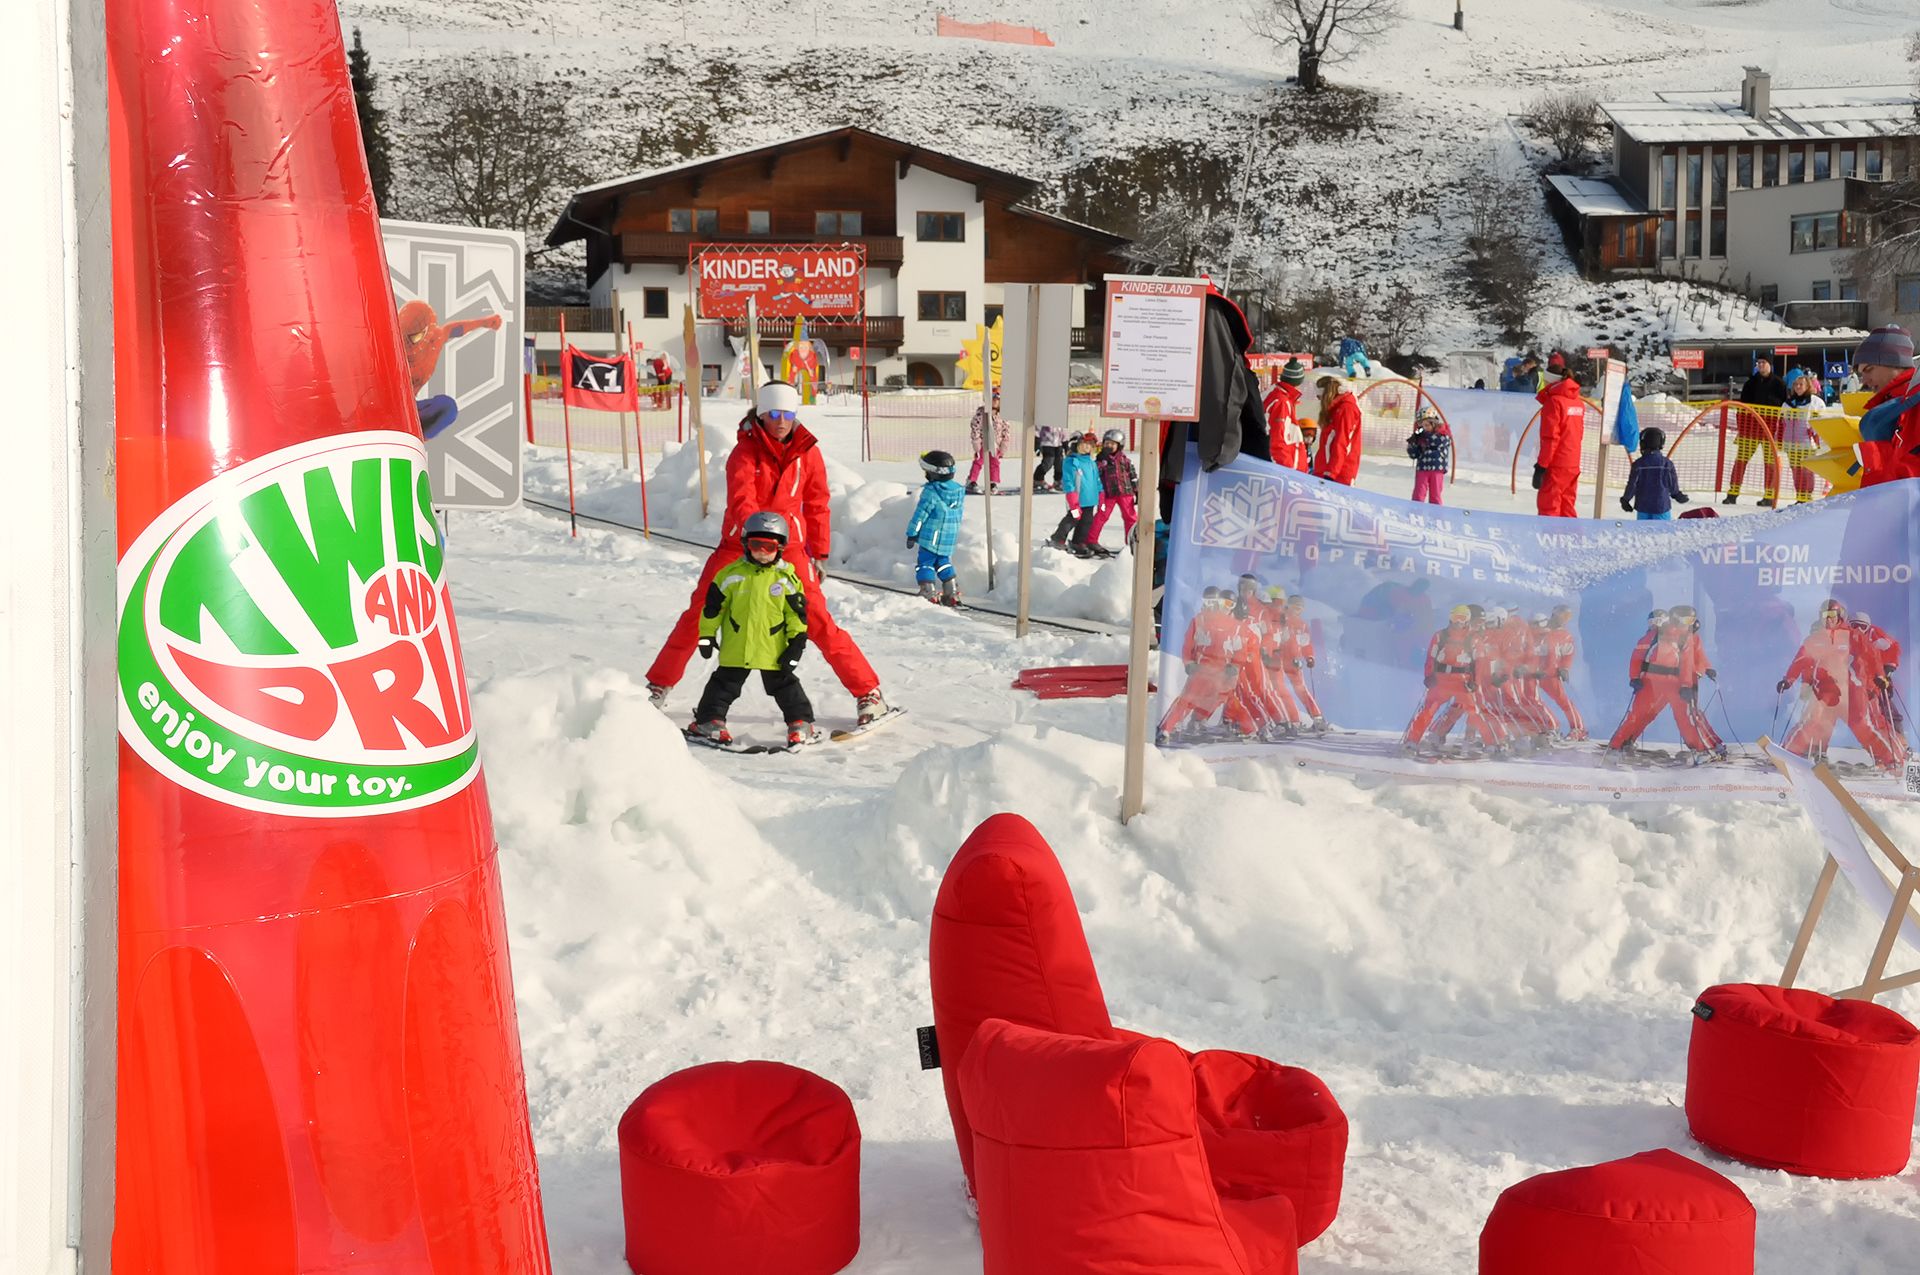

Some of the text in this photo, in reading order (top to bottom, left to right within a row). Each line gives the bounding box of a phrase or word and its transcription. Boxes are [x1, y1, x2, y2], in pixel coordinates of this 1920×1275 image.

[703, 257, 856, 279] KINDER LAND
[1121, 281, 1193, 295] KINDERLAND
[575, 363, 622, 393] A1
[1279, 541, 1512, 584] HOPFGARTEN
[1702, 545, 1809, 565] WELKOM
[1757, 564, 1912, 586] BIENVENIDO
[365, 568, 436, 635] AND
[137, 681, 413, 799] enjoy your toy.
